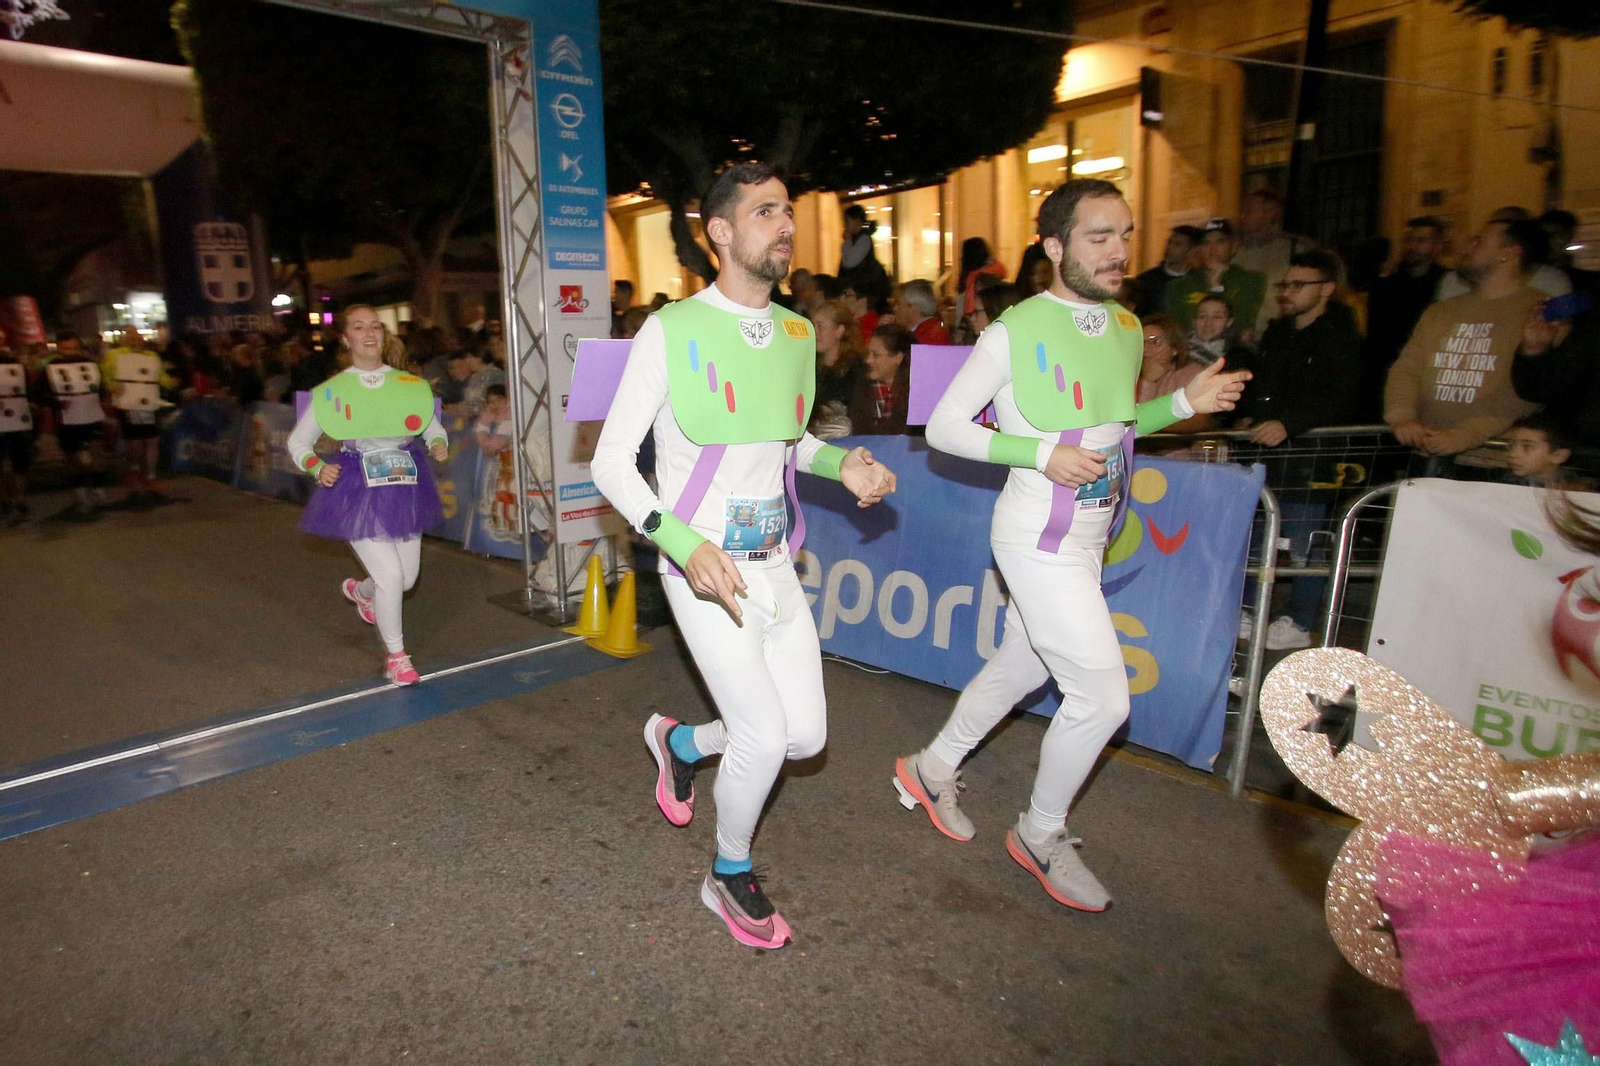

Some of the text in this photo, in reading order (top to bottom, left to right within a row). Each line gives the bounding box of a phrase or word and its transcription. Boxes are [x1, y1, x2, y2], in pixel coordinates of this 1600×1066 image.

[561, 205, 588, 216] GRUPO
[549, 216, 599, 228] SALINAS CAR
[555, 251, 600, 262] DECATHLON
[1456, 322, 1494, 338] PARIS
[1446, 337, 1492, 354] MILANO
[1434, 352, 1497, 371] NEW YORK
[1436, 369, 1484, 387] LONDON
[1435, 385, 1476, 404] TOKYO
[386, 458, 413, 468] 1523
